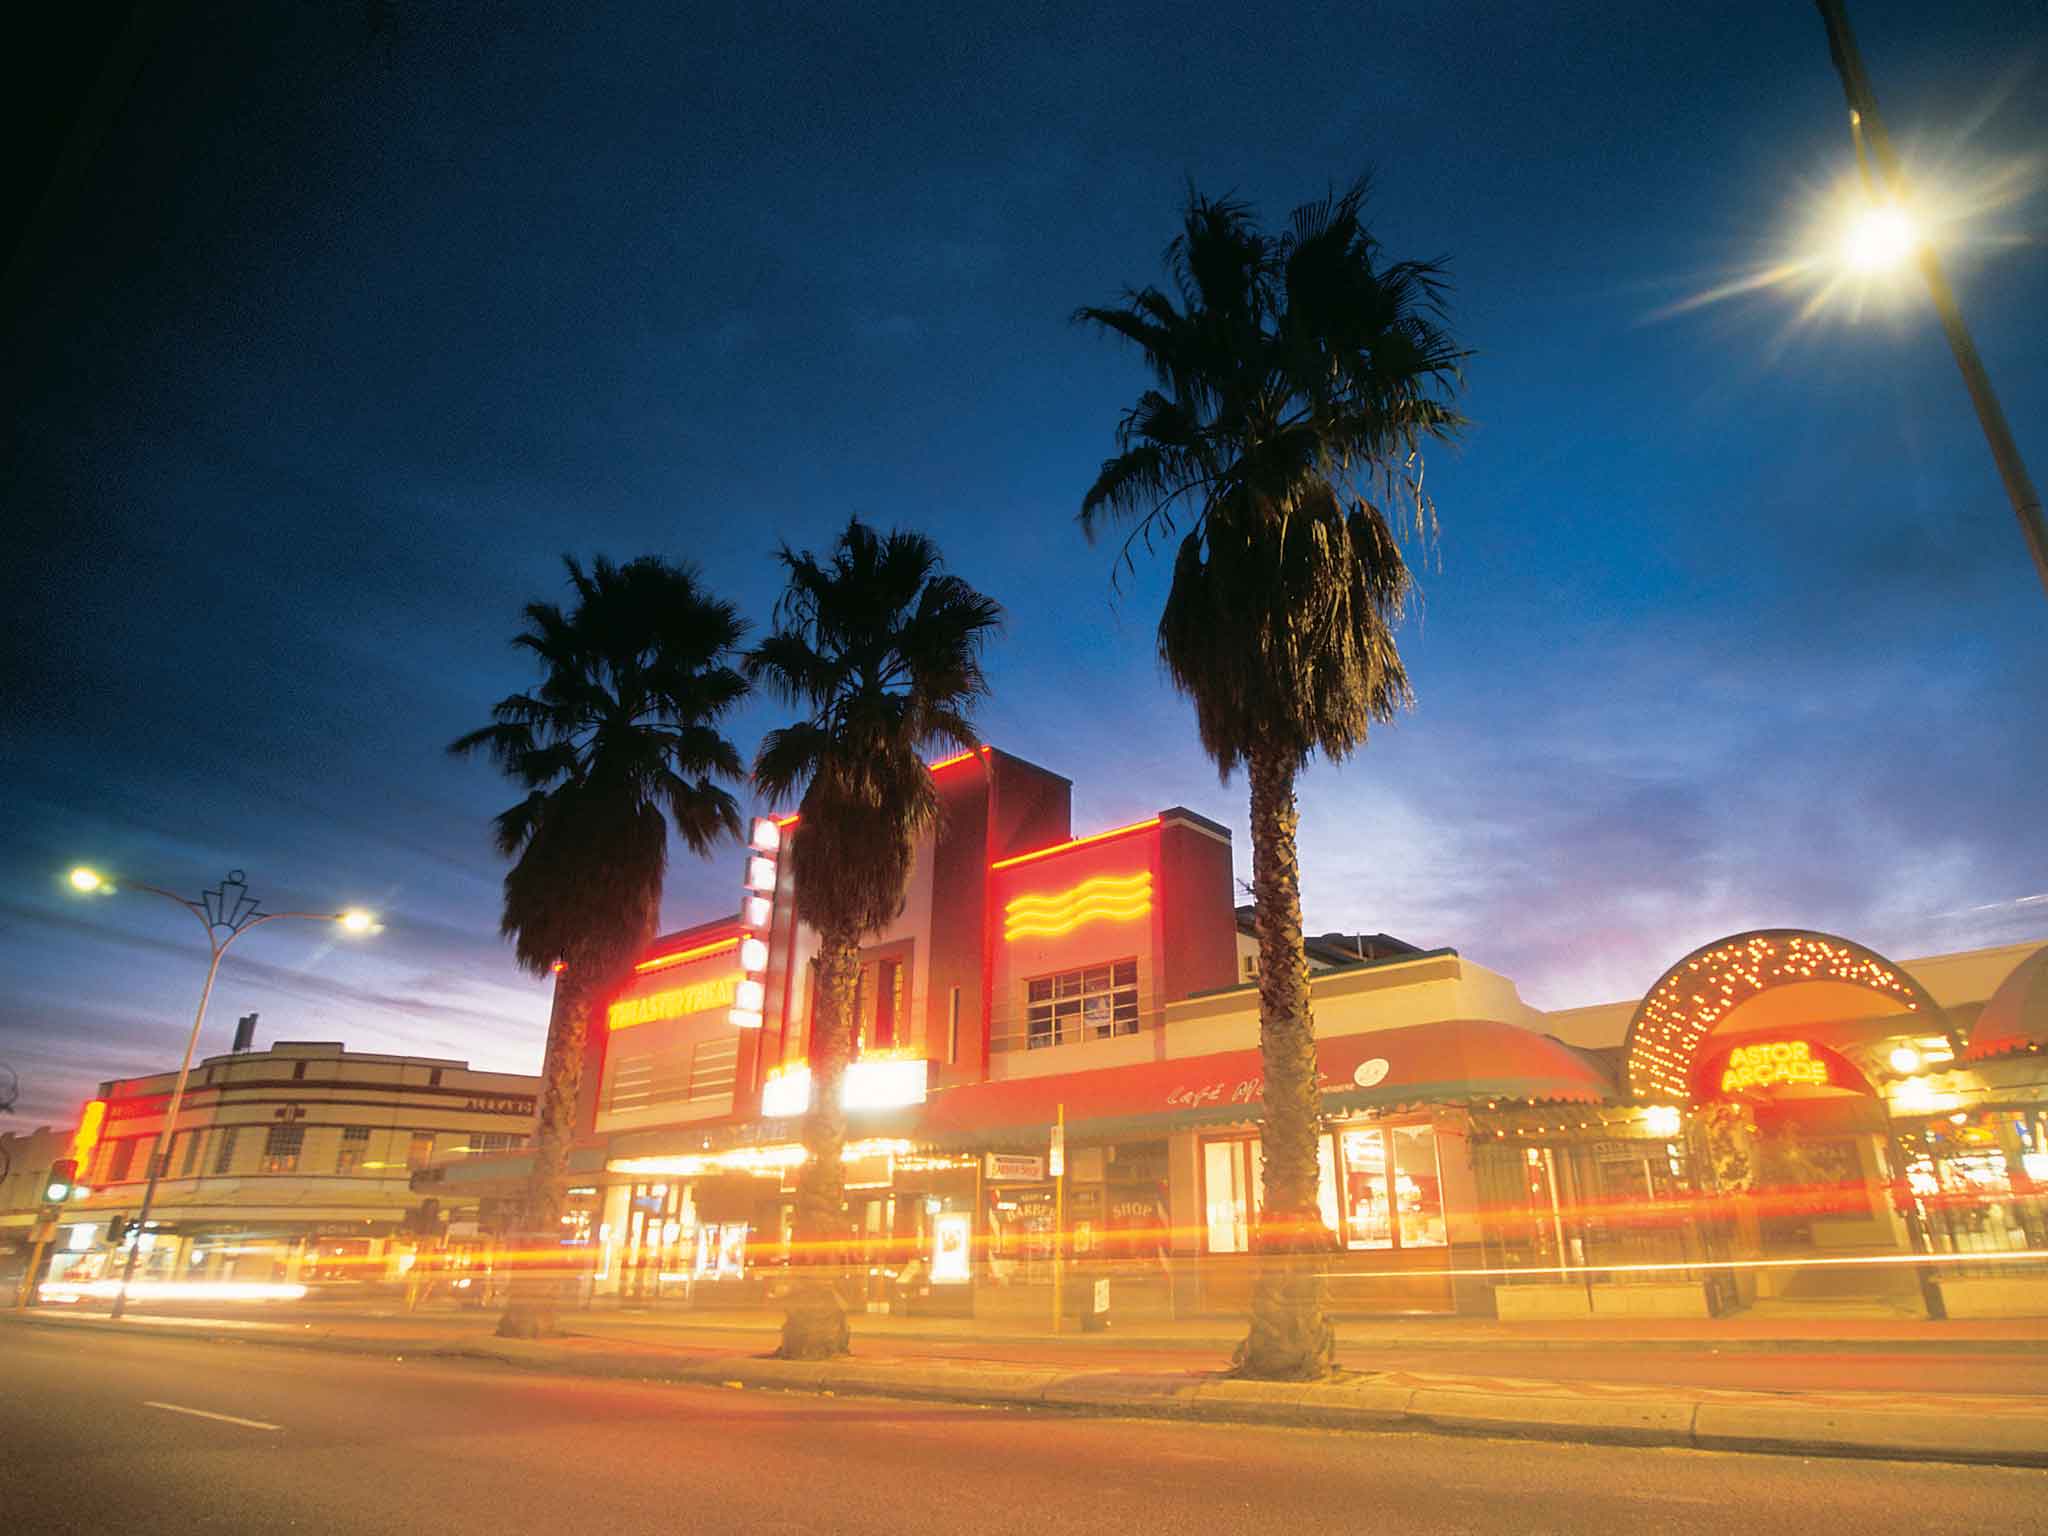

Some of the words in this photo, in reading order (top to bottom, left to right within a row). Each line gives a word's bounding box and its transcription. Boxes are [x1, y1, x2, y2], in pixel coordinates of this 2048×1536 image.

[1729, 1042, 1809, 1067] ASTOR
[1722, 1061, 1827, 1092] ARCADE
[1113, 1202, 1153, 1219] SHOP
